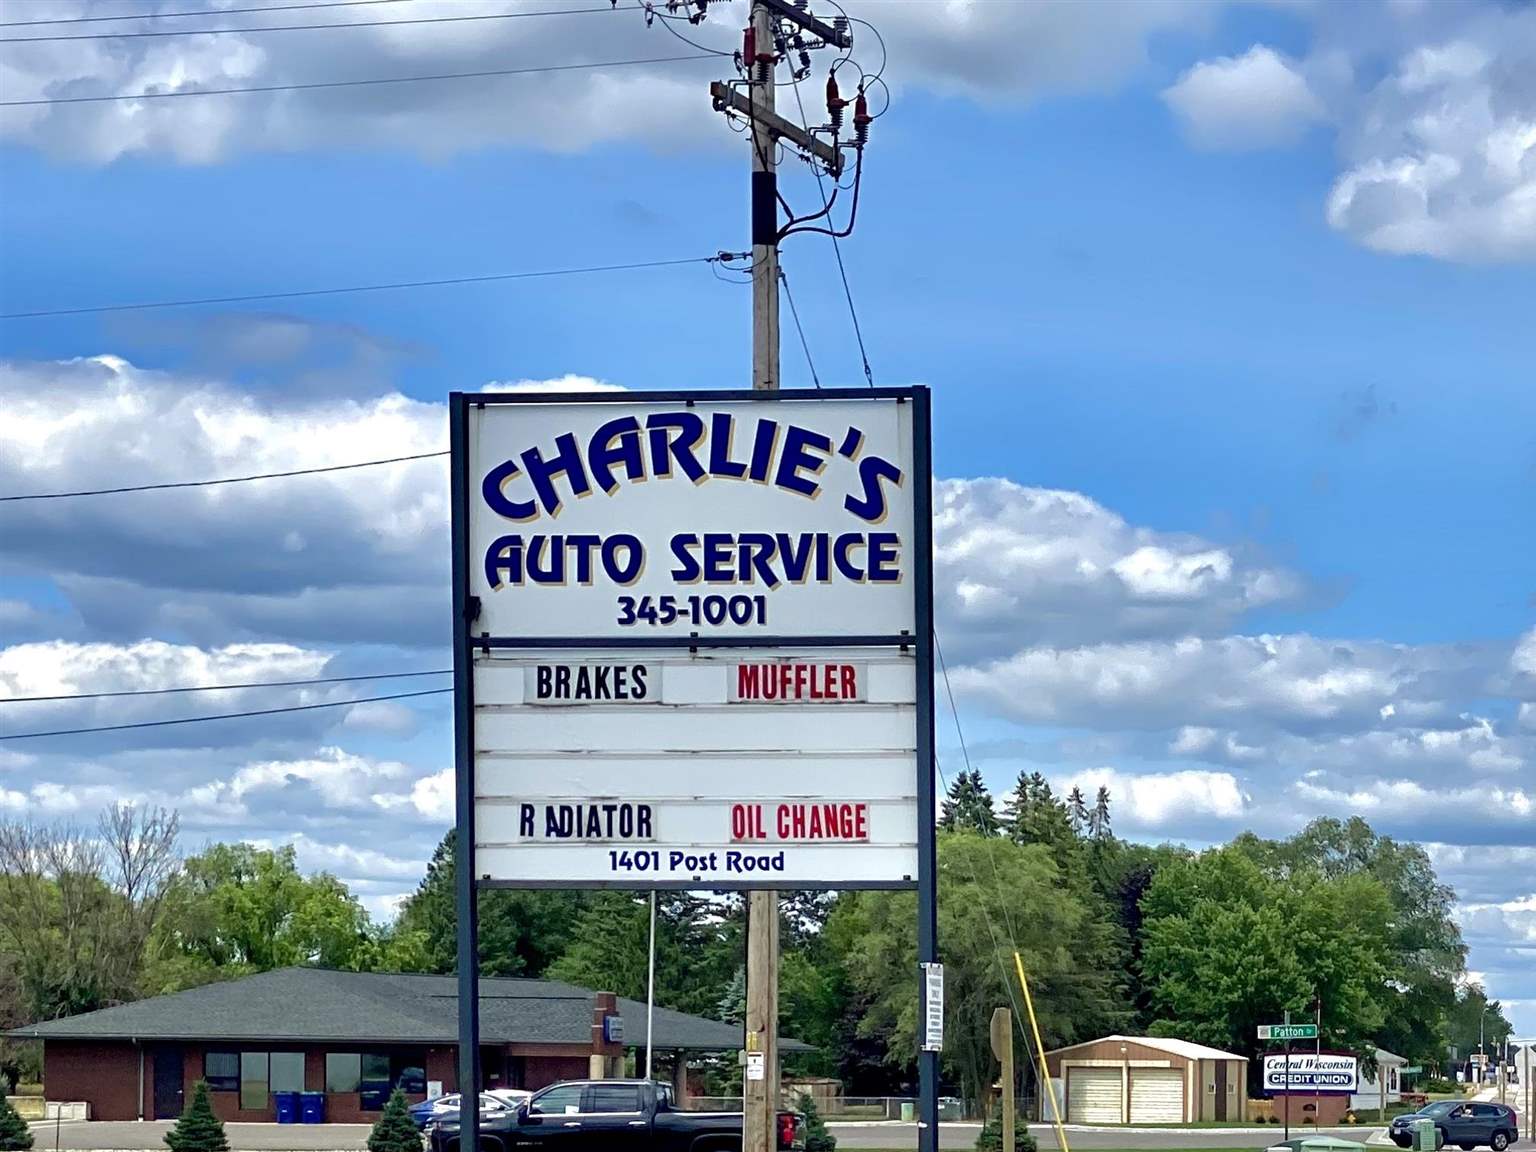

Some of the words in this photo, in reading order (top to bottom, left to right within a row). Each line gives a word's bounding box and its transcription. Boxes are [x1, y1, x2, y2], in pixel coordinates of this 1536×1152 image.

[481, 412, 904, 525] CHARLIE'S
[484, 533, 646, 591] AUTO
[670, 532, 904, 590] SERVICE
[616, 595, 767, 627] 345-1001
[537, 664, 648, 700] BRAKES
[738, 664, 857, 700] MUFFLER
[732, 804, 766, 840] OIL
[776, 804, 867, 840] CHANGE
[609, 851, 660, 872] 1401
[669, 851, 718, 873] Post
[726, 851, 785, 874] Road
[1274, 1027, 1304, 1037] Patton
[1267, 1058, 1303, 1070] Cenral
[1305, 1058, 1354, 1070] Wisconsin
[1271, 1074, 1312, 1084] CREDIT
[1313, 1075, 1349, 1084] UNION
